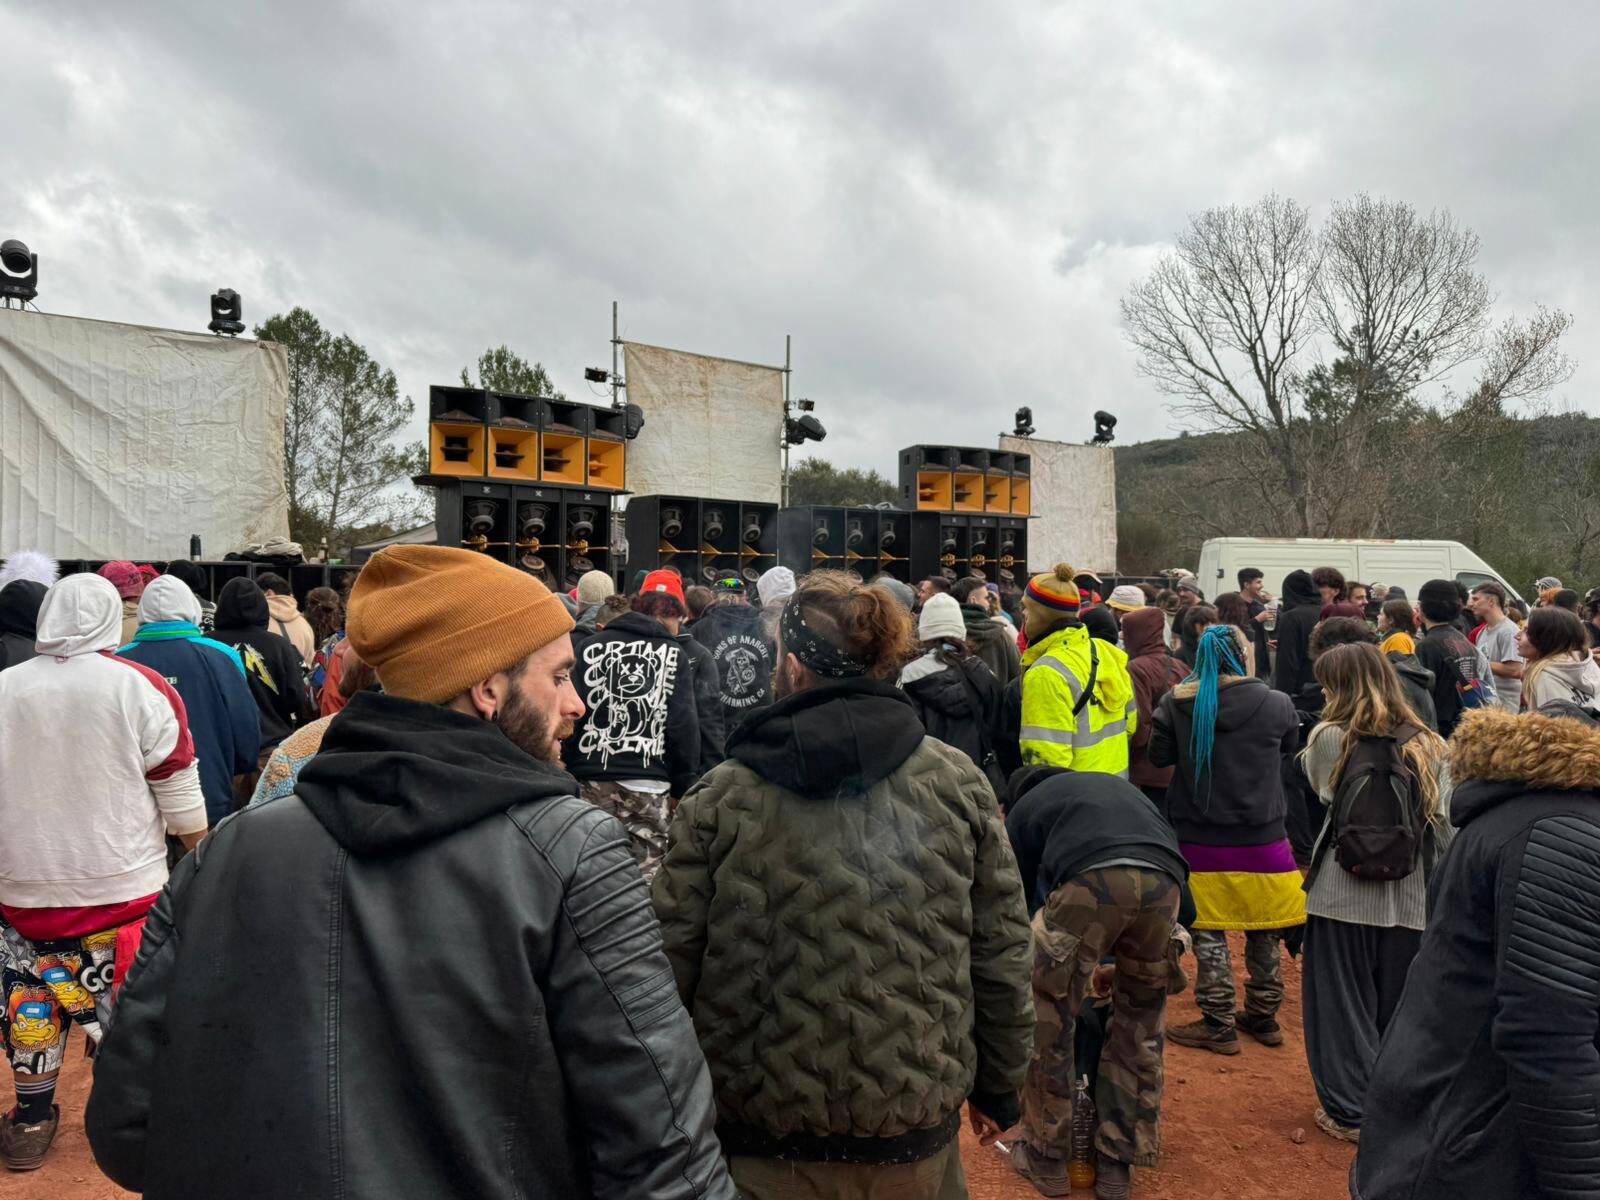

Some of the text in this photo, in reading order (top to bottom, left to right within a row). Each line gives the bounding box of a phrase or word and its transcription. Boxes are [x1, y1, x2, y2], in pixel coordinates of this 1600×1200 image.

[583, 640, 680, 666] CRIME
[727, 635, 737, 645] OF
[740, 635, 769, 658] ANARCHY
[579, 731, 665, 756] CRIME
